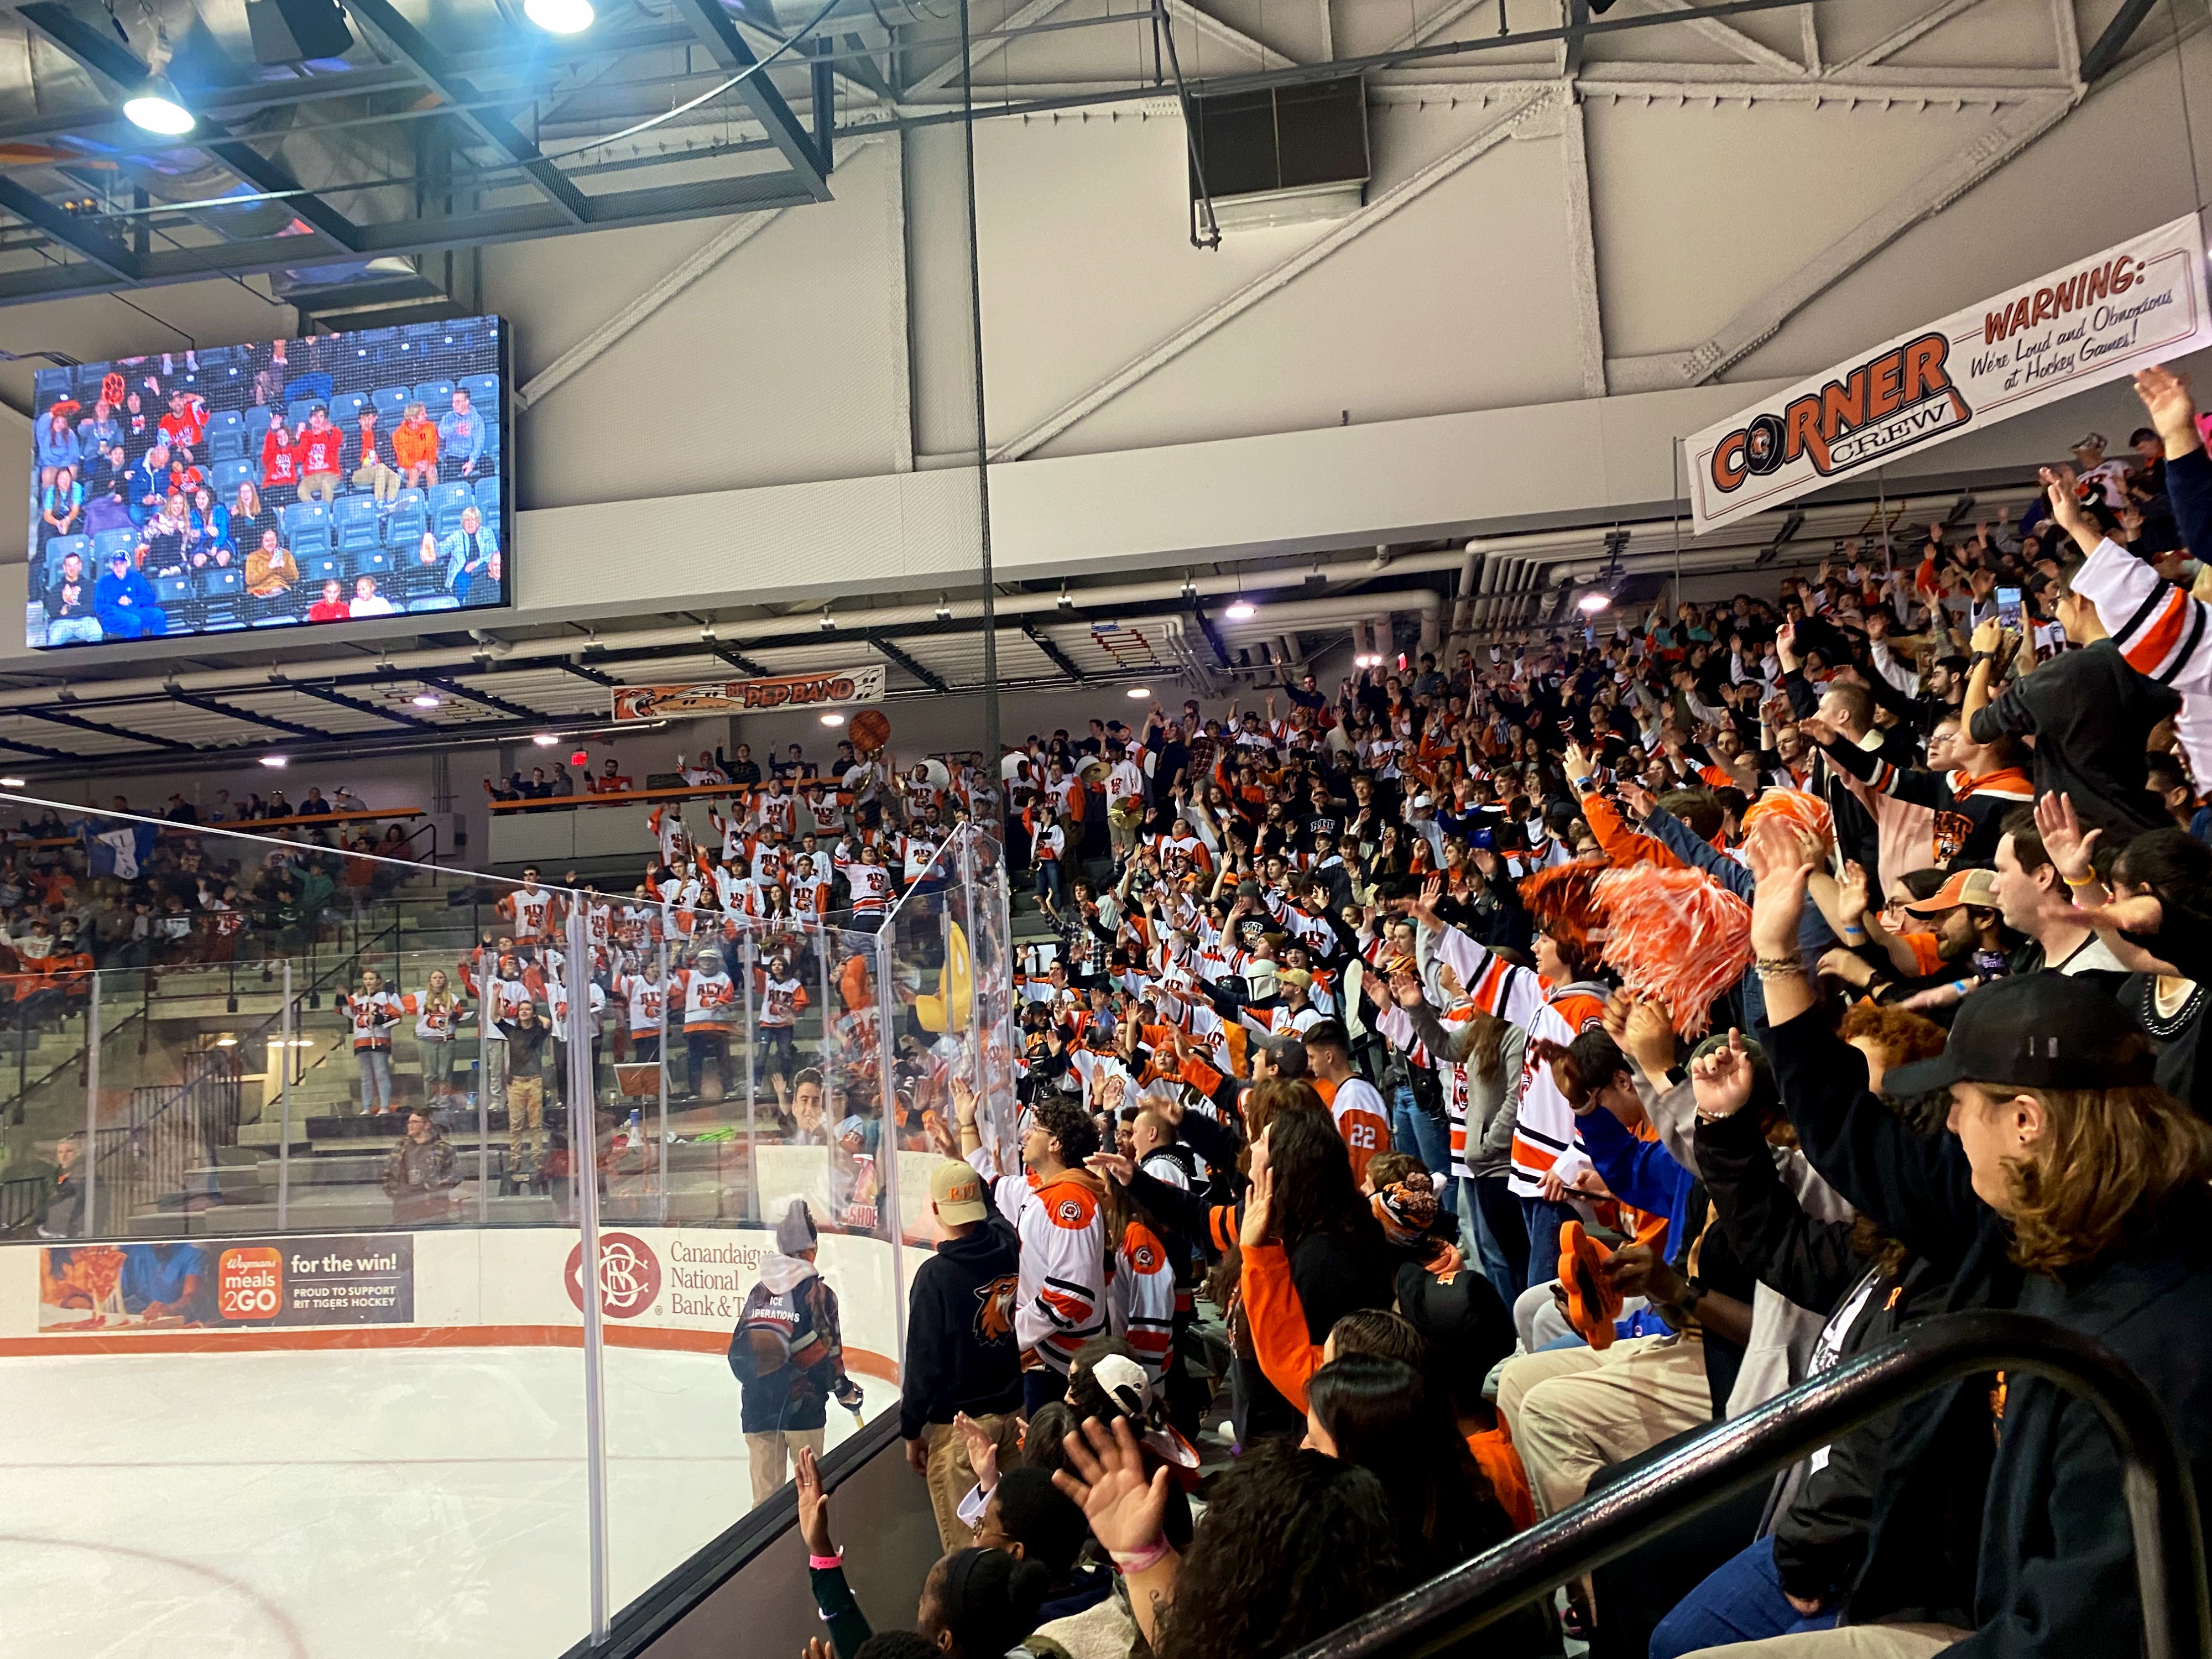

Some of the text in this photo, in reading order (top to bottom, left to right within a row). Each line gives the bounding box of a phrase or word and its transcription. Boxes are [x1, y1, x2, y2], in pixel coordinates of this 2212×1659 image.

[1985, 255, 2146, 345] WARNING:
[2016, 331, 2052, 361] Loud
[2057, 317, 2086, 346] and
[2093, 288, 2172, 331] Obnoxious
[2004, 318, 2138, 390] at Hockey Games!
[1712, 333, 1953, 492] CORNER
[1832, 401, 1949, 463] CREW
[744, 684, 790, 708] PEP
[790, 678, 855, 703] BAND
[1311, 819, 1335, 833] RIT
[794, 888, 813, 898] RIT
[846, 1131, 862, 1145] 30
[1350, 1124, 1375, 1149] 22
[948, 1183, 975, 1201] RIT
[226, 1254, 276, 1275] Wegmans
[291, 1253, 397, 1273] for the win!
[225, 1270, 275, 1288] meals
[671, 1267, 739, 1291] National
[225, 1289, 276, 1311] 2GO
[294, 1286, 397, 1297] PROUD TO SUPPORT
[294, 1297, 396, 1308] RIT TIGERS HOCKEY
[769, 1296, 784, 1307] ICE
[1883, 1287, 1902, 1311] R
[671, 1293, 714, 1315] Bank
[717, 1296, 733, 1317] &
